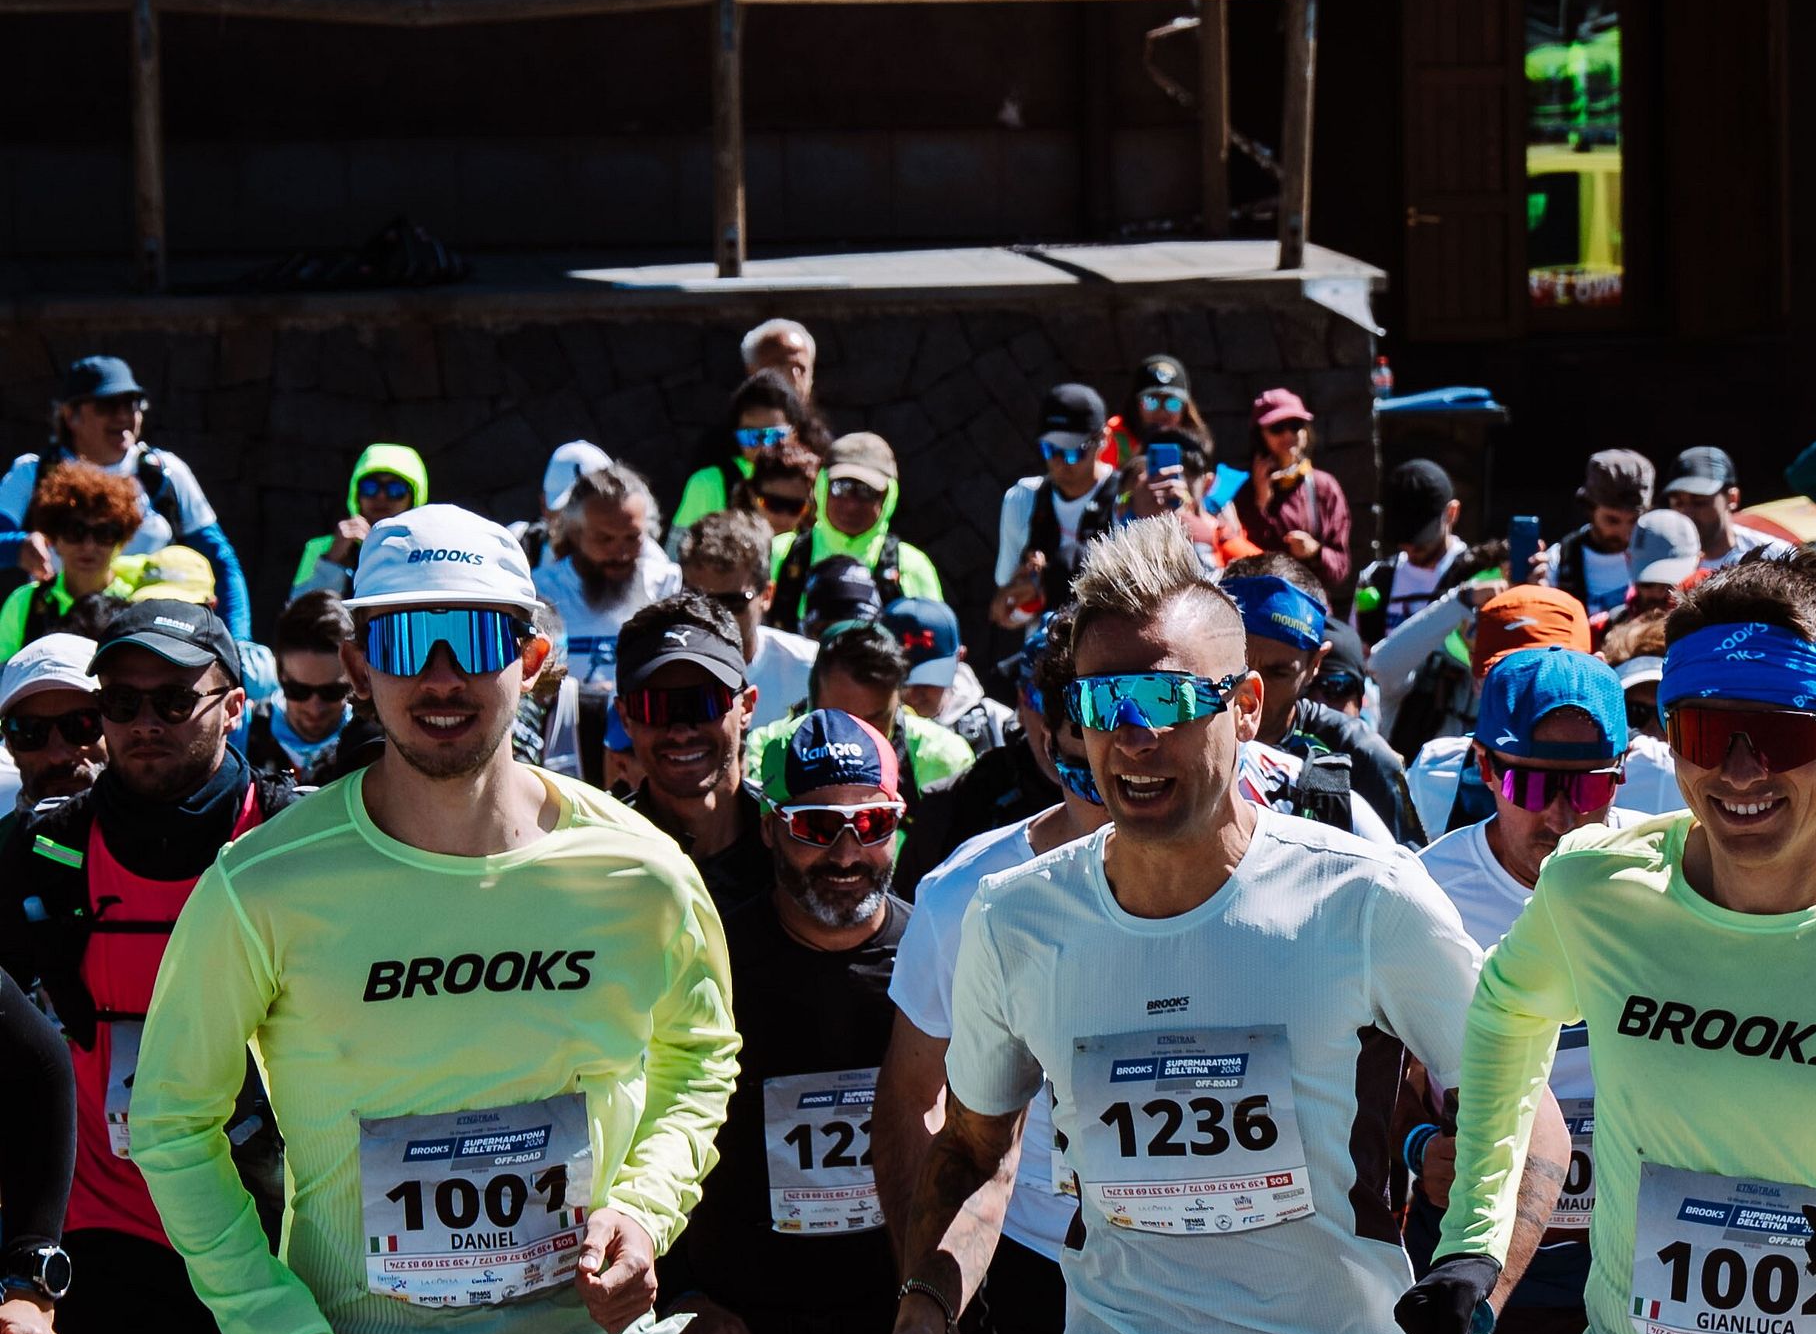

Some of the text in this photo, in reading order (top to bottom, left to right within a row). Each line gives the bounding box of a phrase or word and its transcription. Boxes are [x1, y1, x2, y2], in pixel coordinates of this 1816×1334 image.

[407, 549, 484, 565] BROOKS
[364, 950, 595, 1002] BROOKS
[1147, 996, 1190, 1010] BROOKS
[1166, 1058, 1242, 1068] SUPERMARATONA
[1116, 1065, 1152, 1075] BROOKS
[1164, 1065, 1241, 1076] DELL'ETNA 2026
[1195, 1079, 1238, 1088] OFF-ROAD
[844, 1090, 875, 1098] SUPERM
[1100, 1095, 1279, 1157] 1236
[464, 1130, 546, 1147] SUPERMARATONA
[410, 1145, 449, 1155] BROOKS
[462, 1138, 544, 1155] DELL'ETNA 2026
[494, 1151, 541, 1166] OFF-ROAD
[1270, 1176, 1289, 1185] SOS
[386, 1164, 568, 1231] 1001
[1685, 1205, 1725, 1219] BROOKS
[1736, 1218, 1788, 1231] DELL'ETNA
[451, 1231, 518, 1250] DANIEL
[555, 1236, 574, 1248] SOS
[1768, 1235, 1805, 1247] OFF-RO
